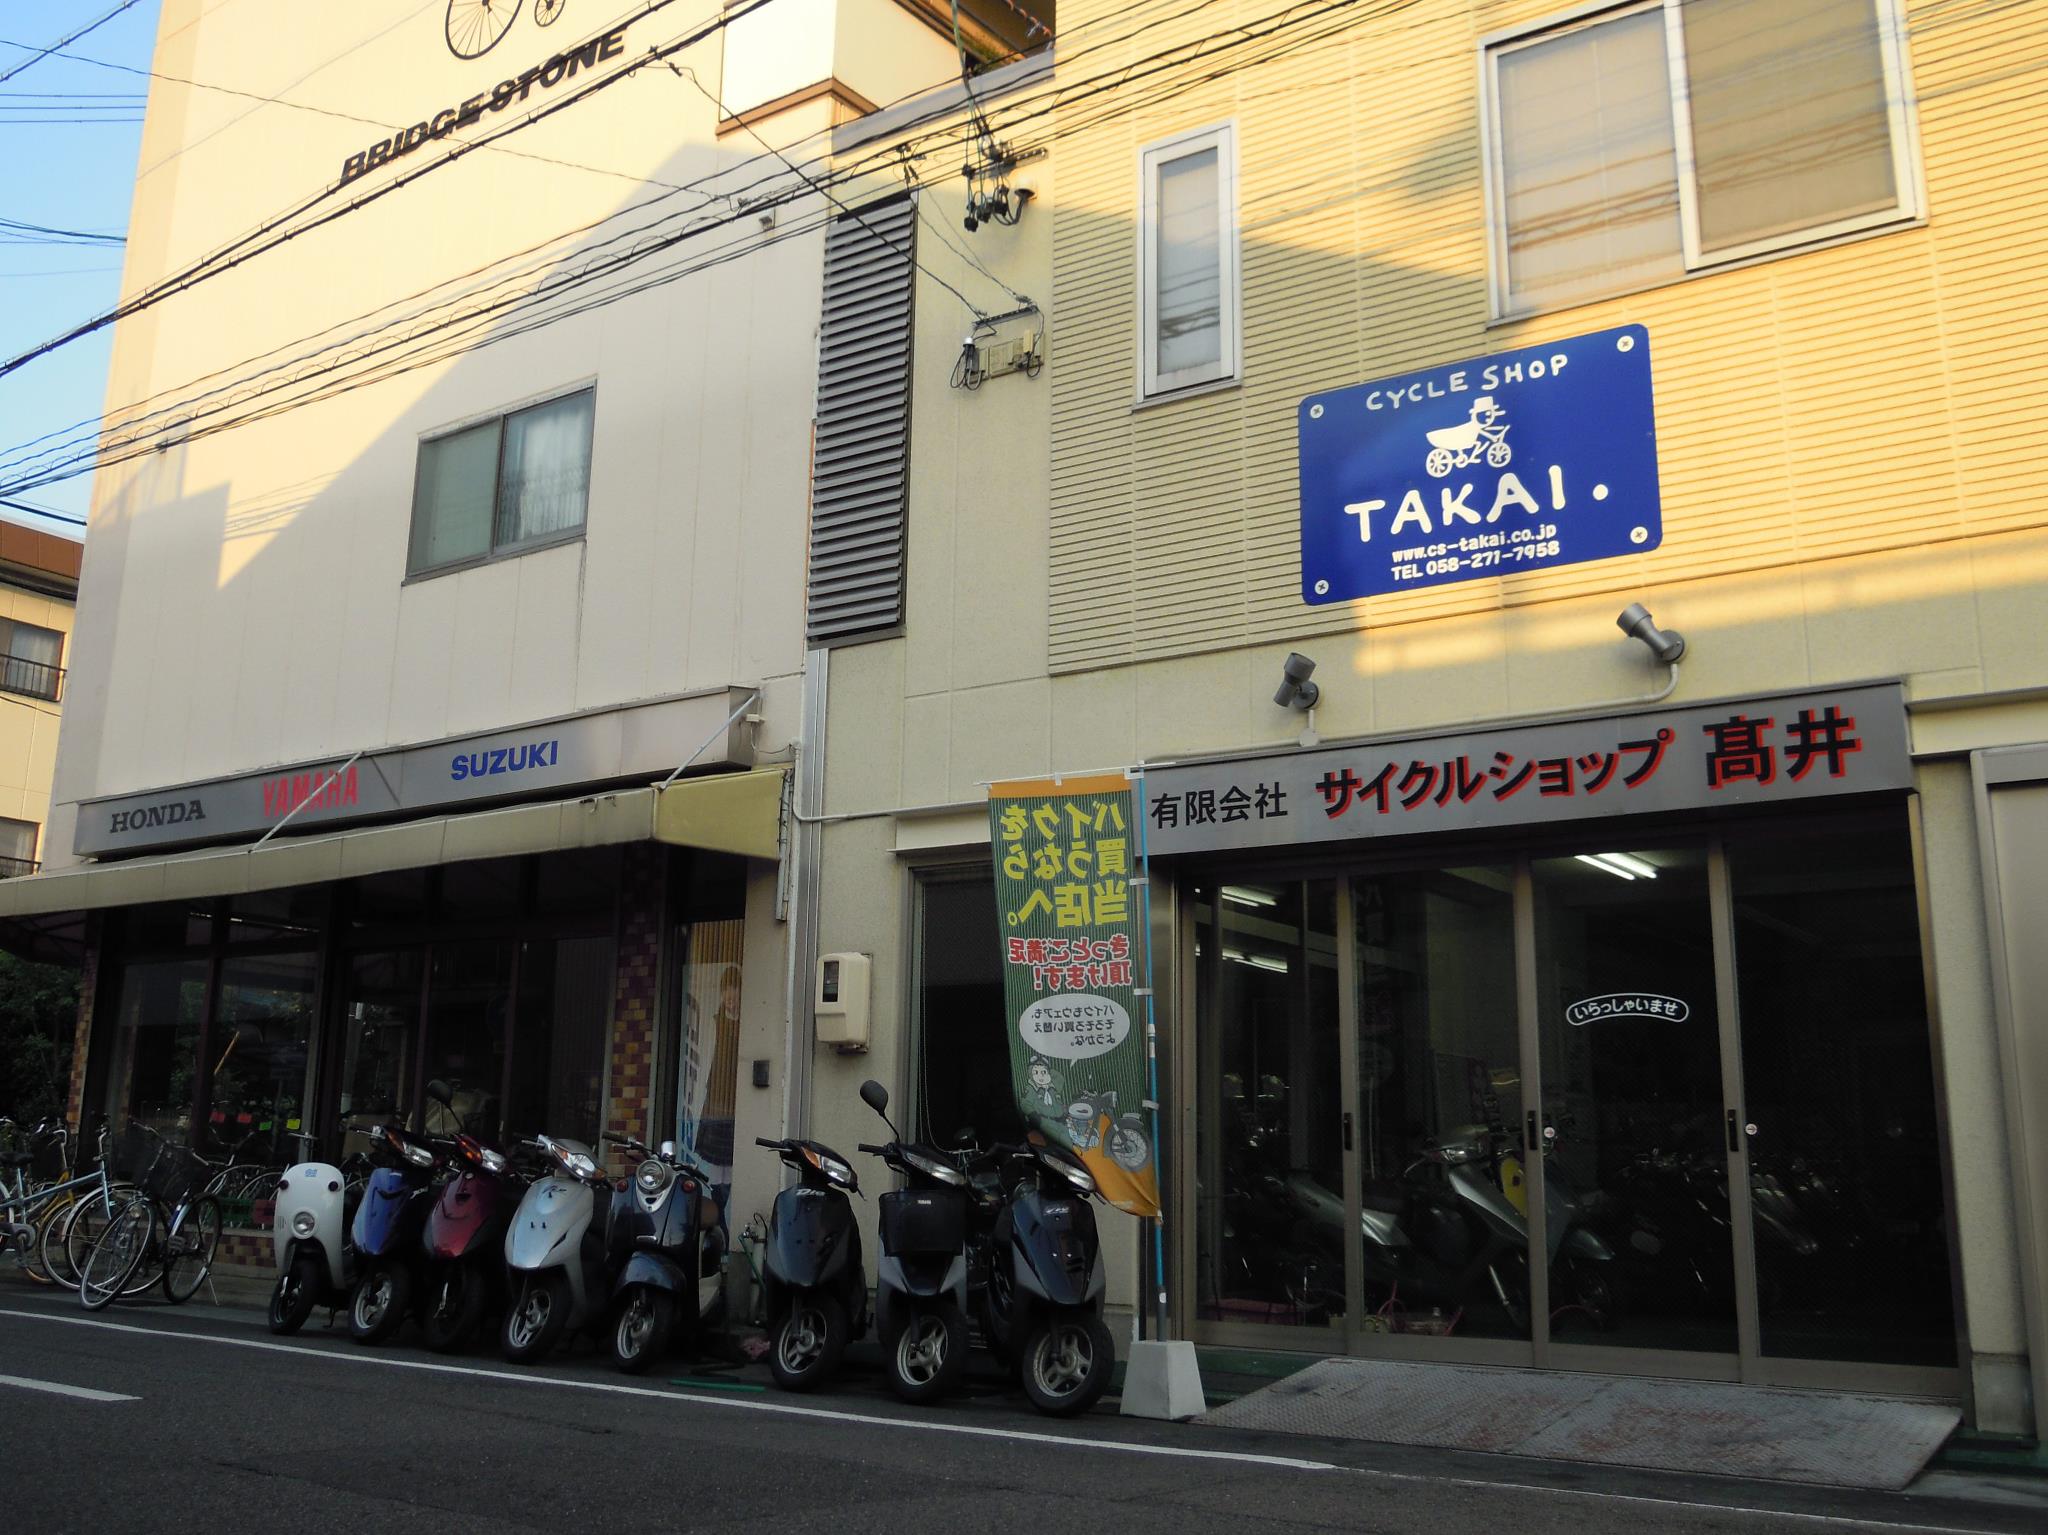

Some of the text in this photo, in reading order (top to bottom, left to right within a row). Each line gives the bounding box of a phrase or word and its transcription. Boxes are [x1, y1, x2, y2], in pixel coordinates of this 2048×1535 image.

[1366, 354, 1569, 411] CYCLE SHOP
[1391, 524, 1557, 563] www.cs-takai.co.jp
[1391, 541, 1561, 581] TEL 058-271-7958
[450, 740, 559, 781] SUZUKI
[1151, 783, 1288, 829] 有限会社
[1315, 728, 1675, 819] サイクルショップ
[262, 766, 359, 818] YAMAHA
[110, 800, 206, 834] HONDA
[1574, 998, 1678, 1020] いらっしゃいませ
